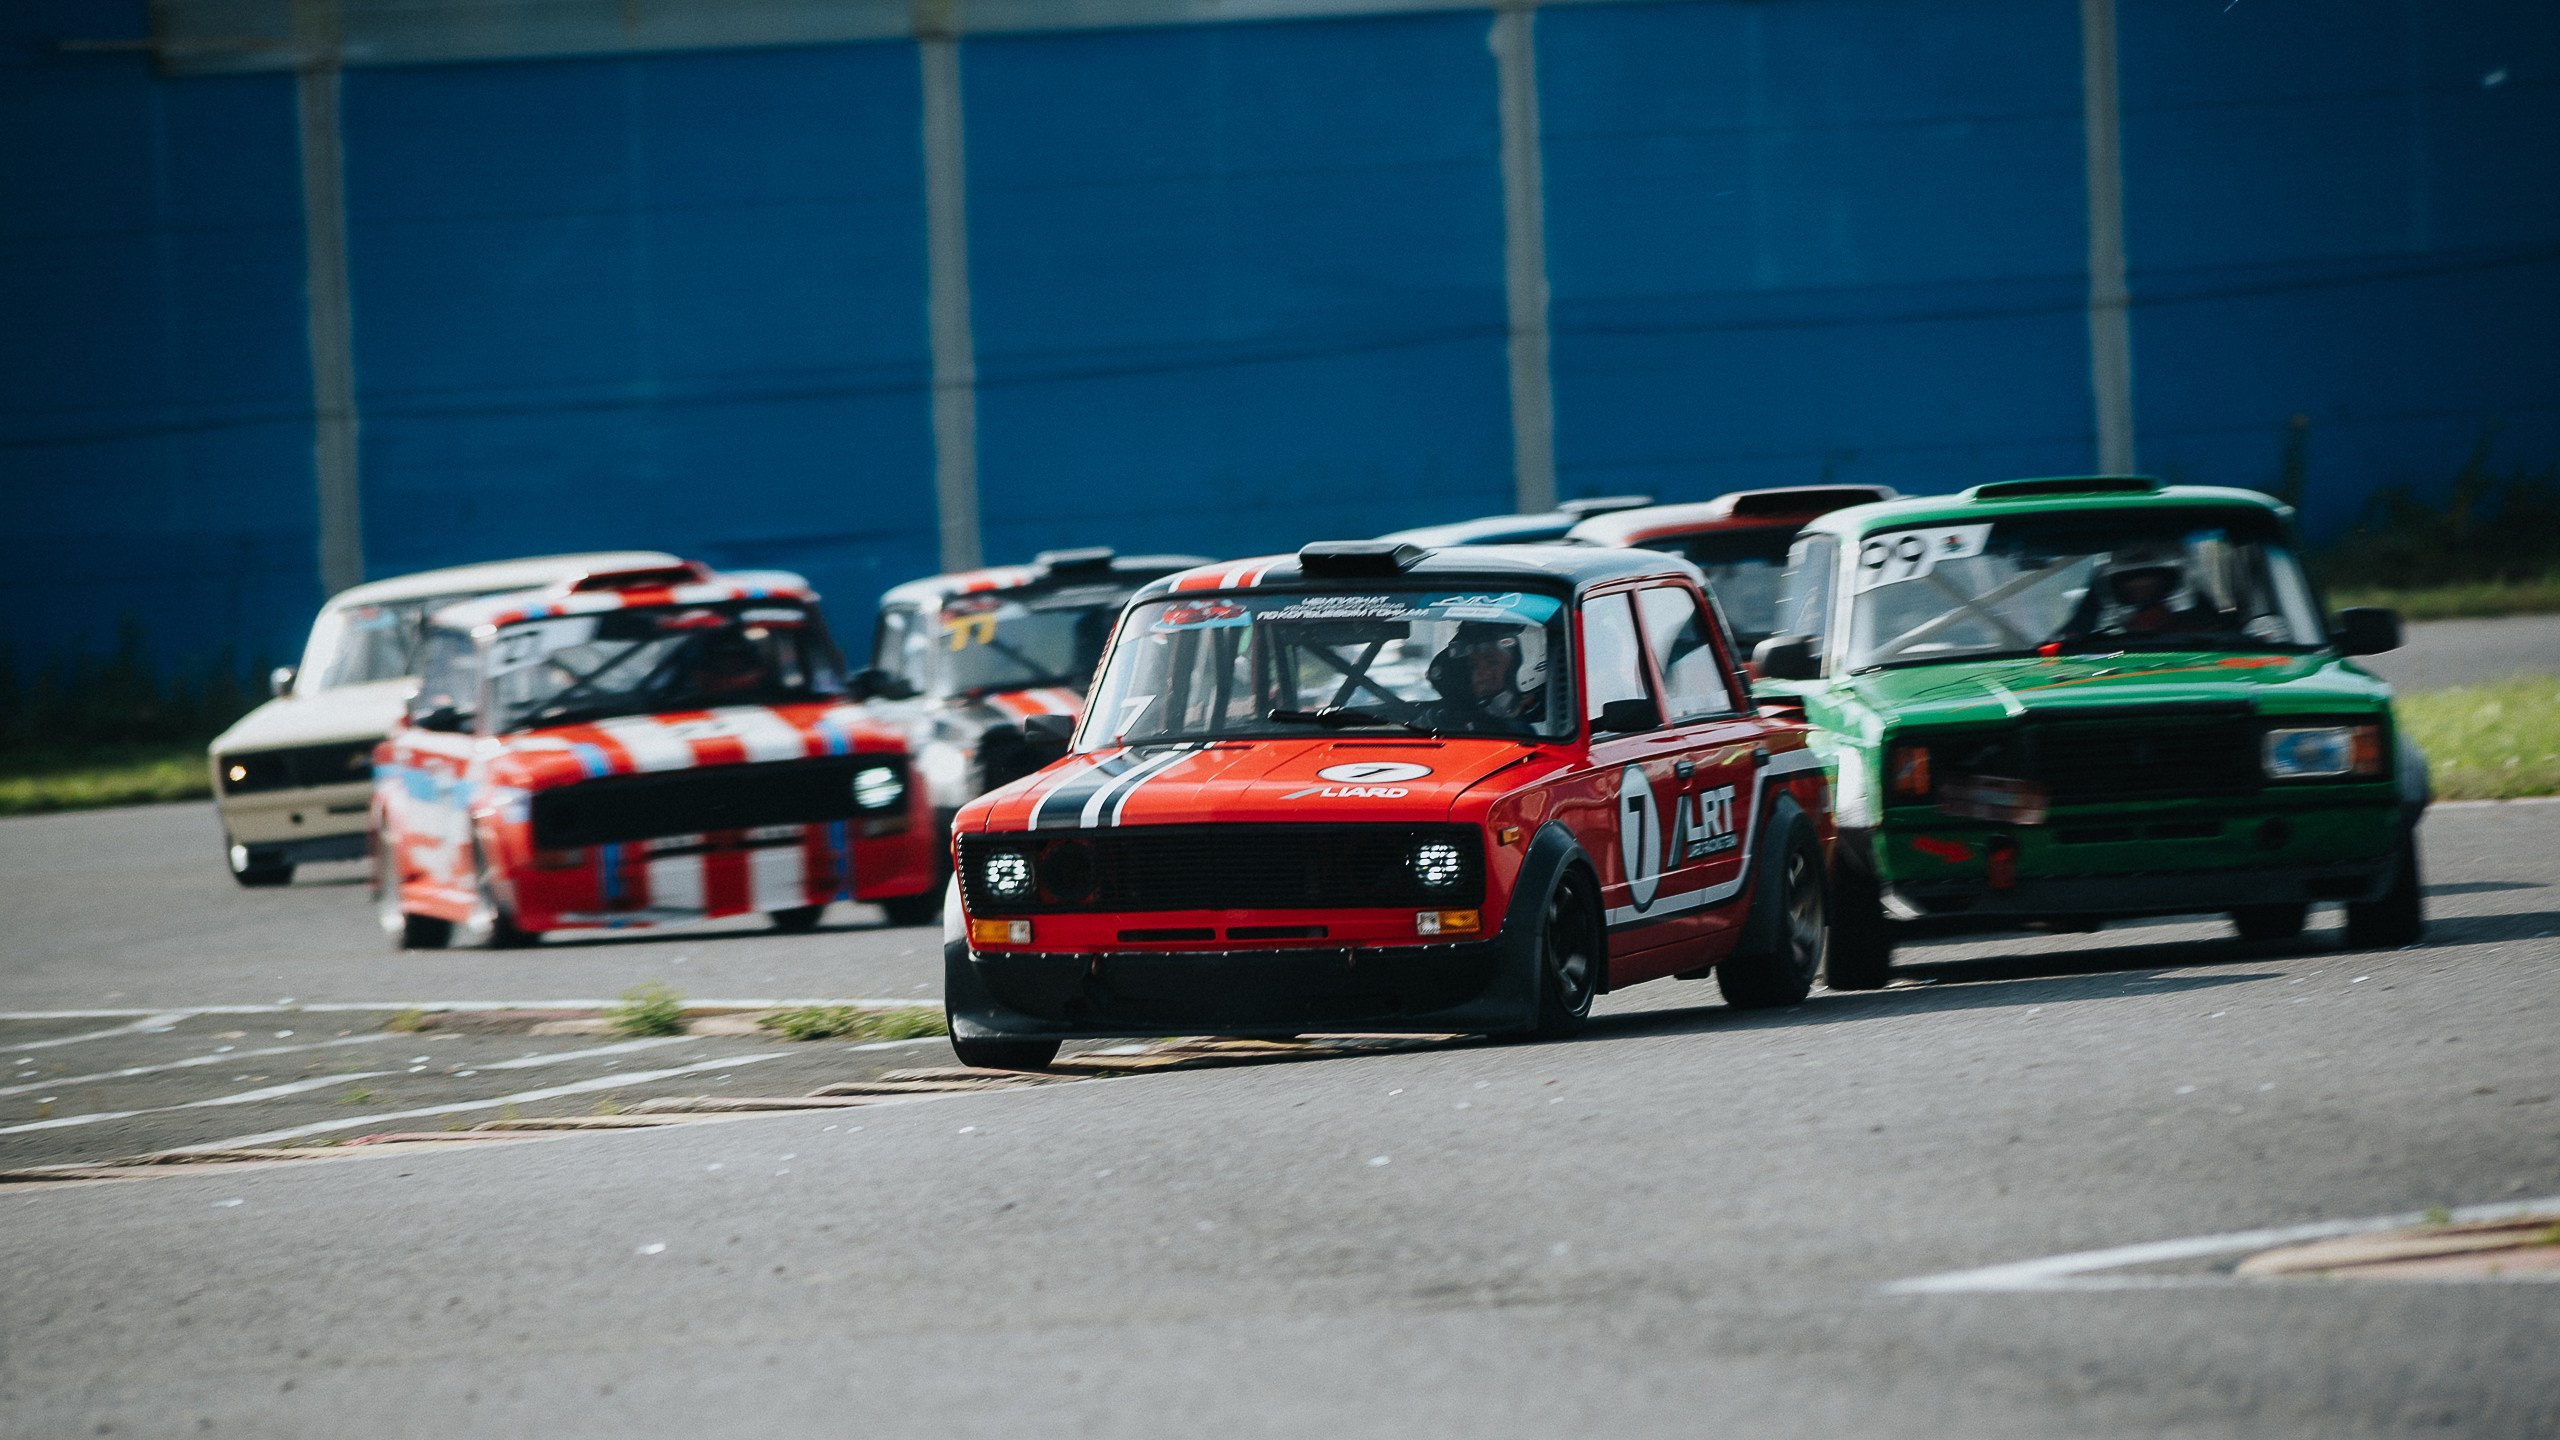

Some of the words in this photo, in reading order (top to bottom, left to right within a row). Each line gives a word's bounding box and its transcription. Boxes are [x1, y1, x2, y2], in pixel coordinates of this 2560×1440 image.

[1857, 535, 1926, 583] 99
[942, 613, 998, 652] 77
[1114, 694, 1158, 738] 7
[1319, 786, 1410, 799] LIARD
[1347, 766, 1406, 779] 7
[1685, 784, 1736, 842] LRT
[1627, 793, 1648, 882] 7
